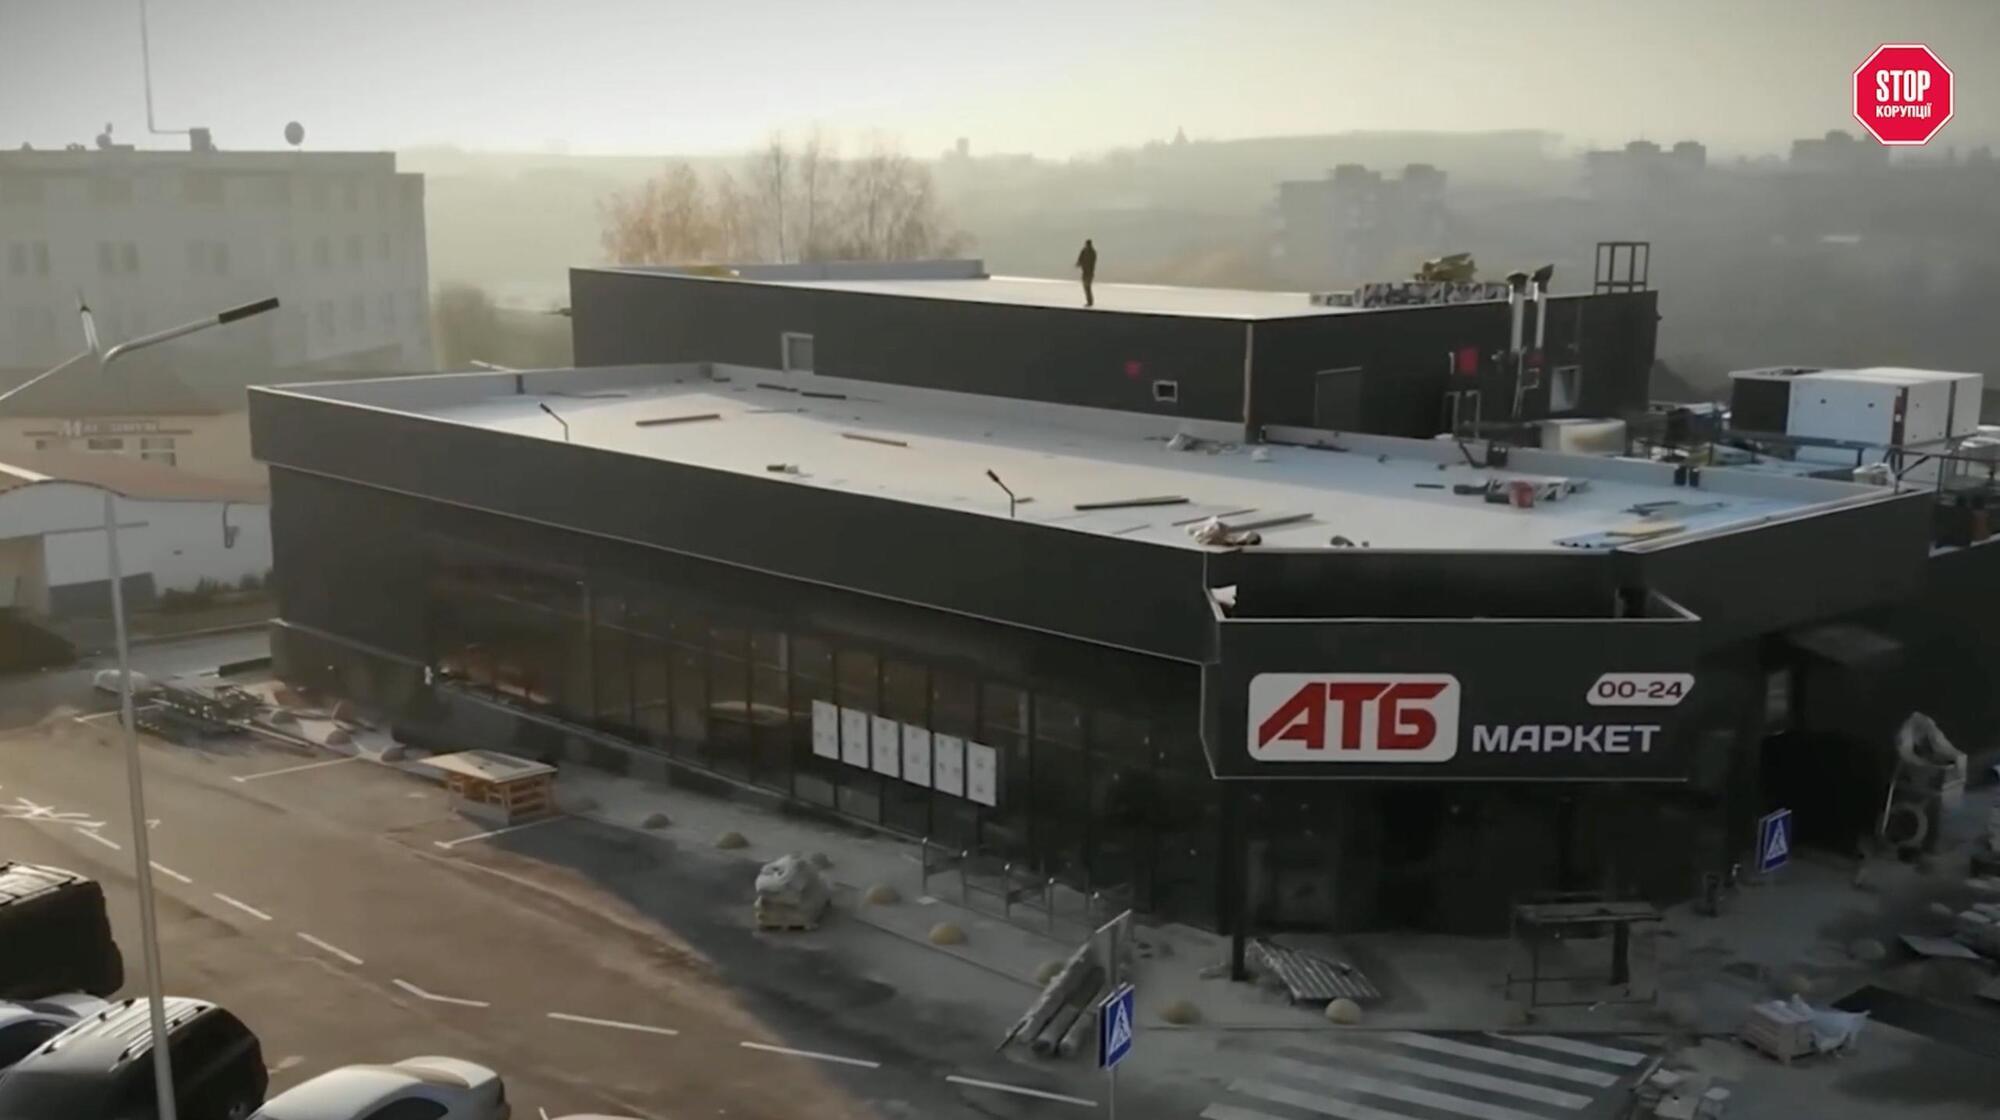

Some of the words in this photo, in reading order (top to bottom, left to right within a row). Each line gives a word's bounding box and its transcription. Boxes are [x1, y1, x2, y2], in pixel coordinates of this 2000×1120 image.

[1598, 681, 1683, 699] 00-24
[1259, 682, 1449, 750] АТБ
[1472, 724, 1661, 752] МАРКЕТ
